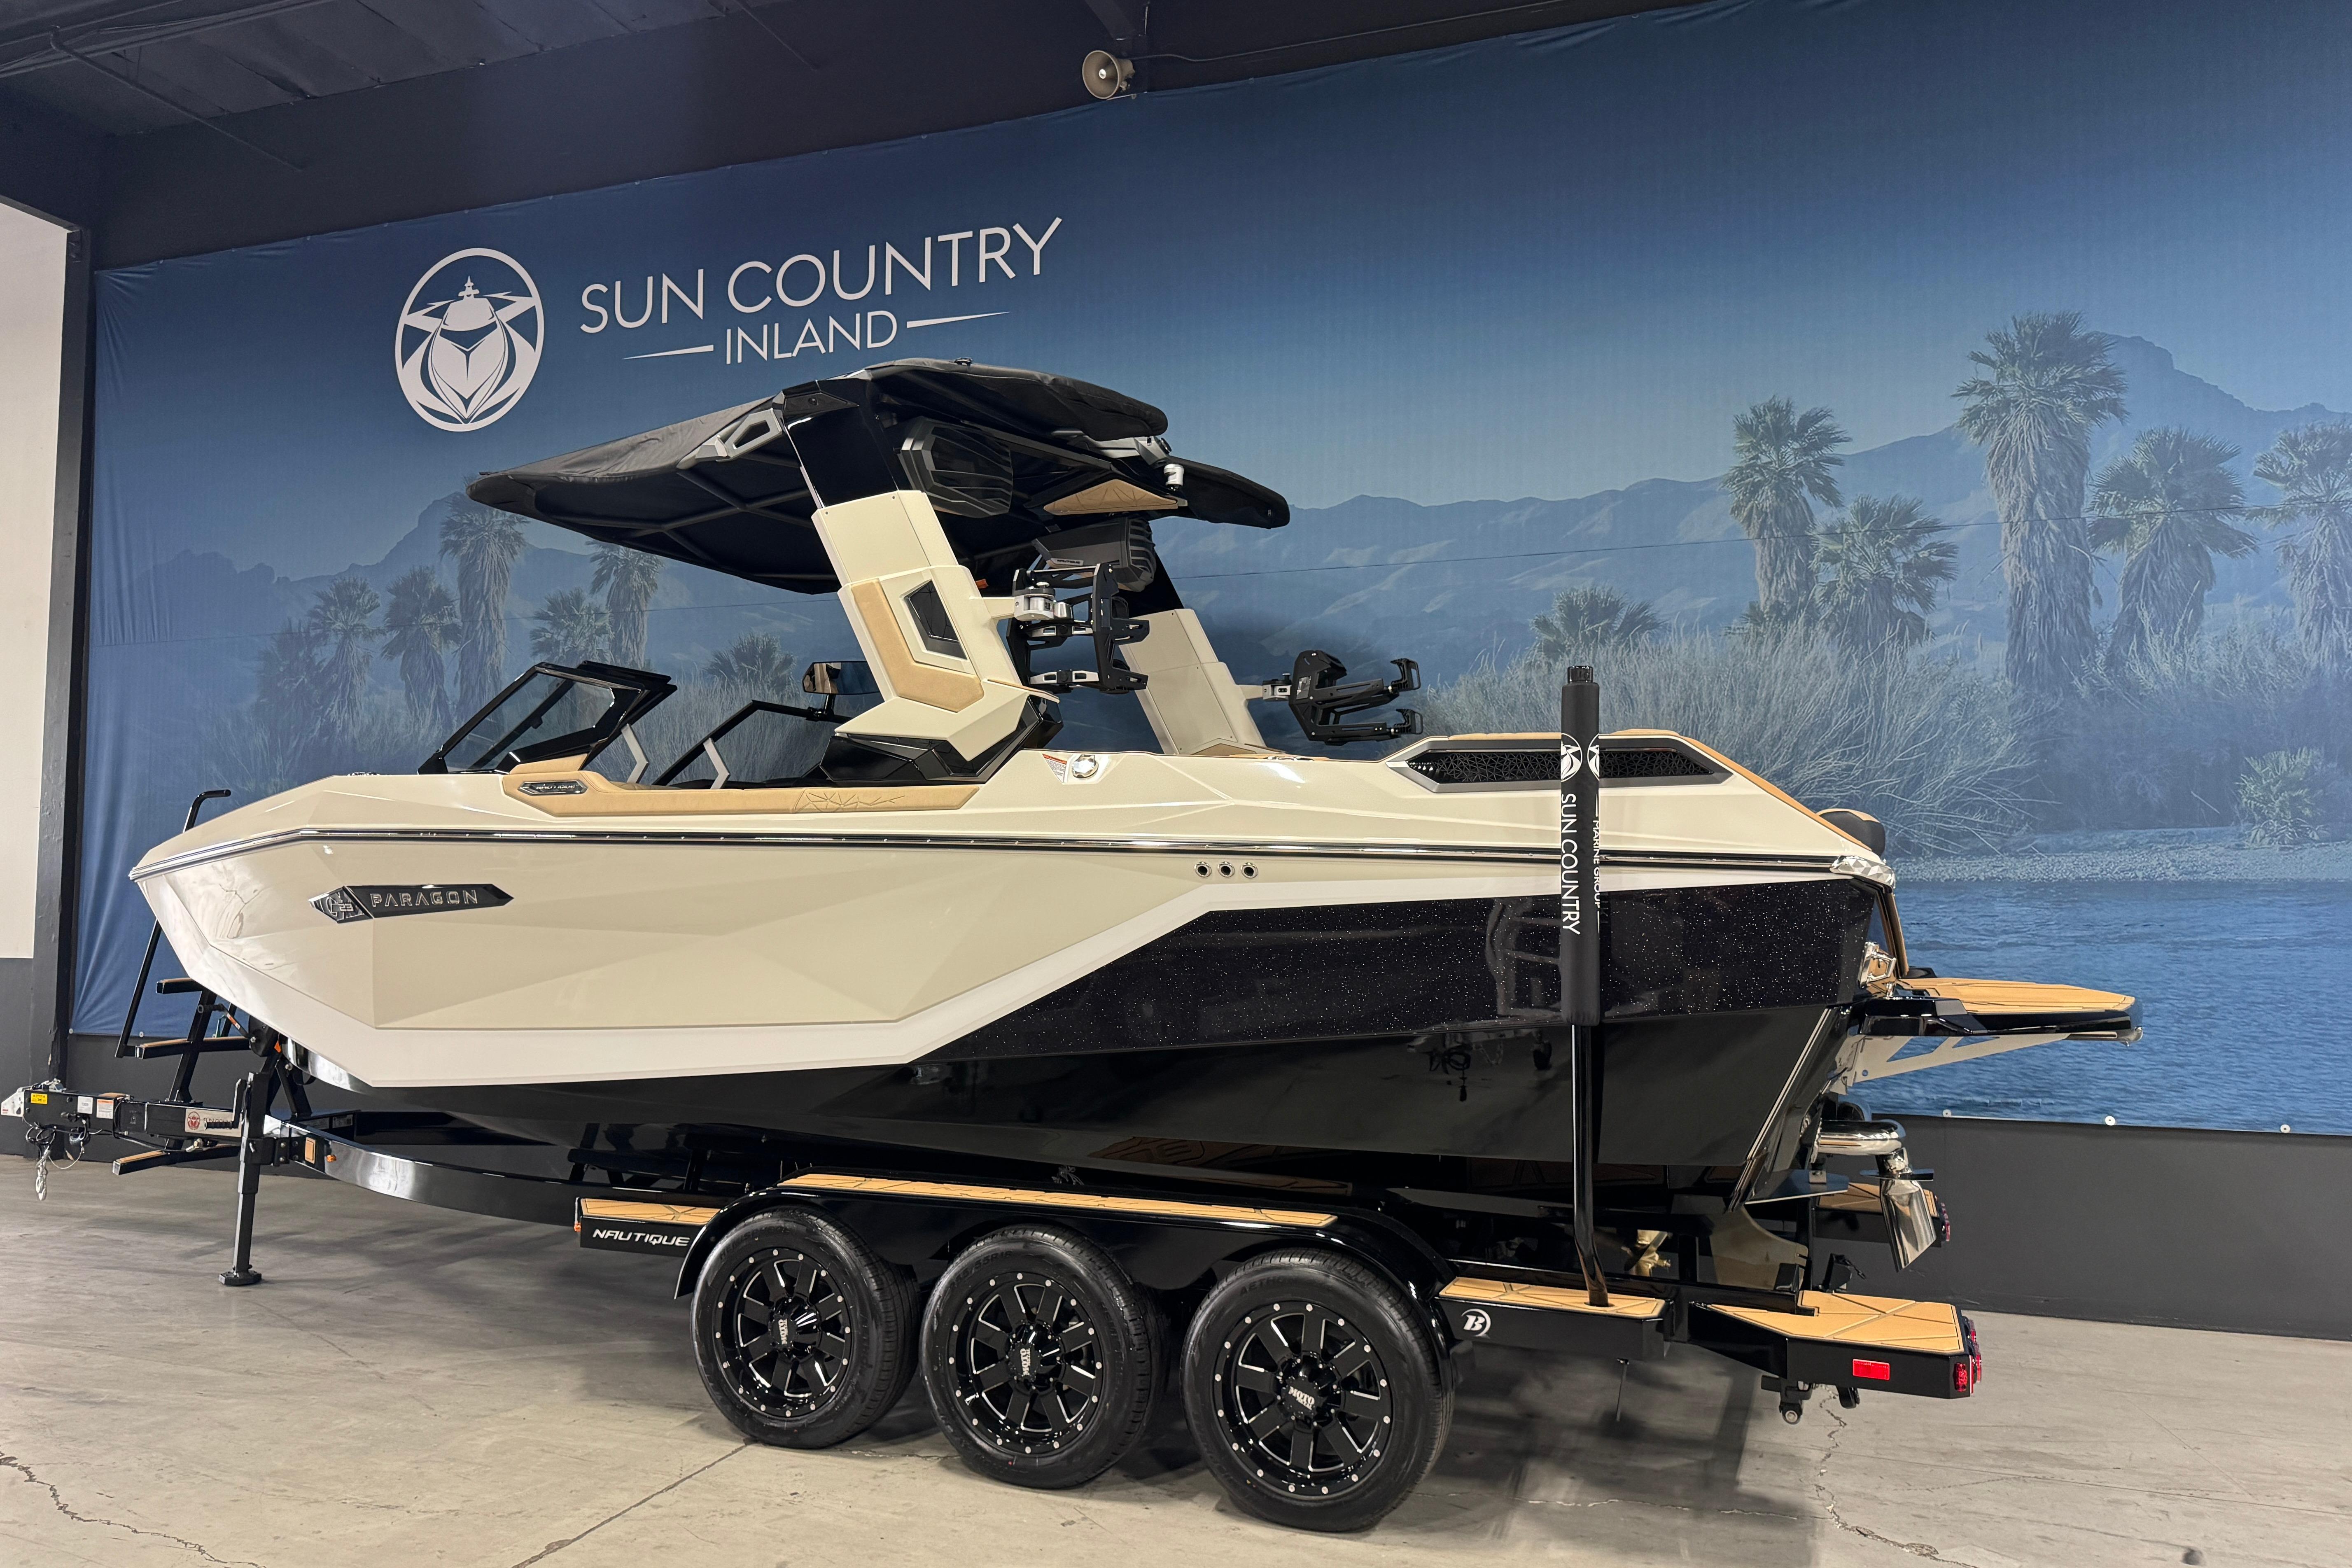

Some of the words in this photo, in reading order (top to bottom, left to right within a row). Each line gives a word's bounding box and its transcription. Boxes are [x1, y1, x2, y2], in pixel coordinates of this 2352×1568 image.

[581, 269, 703, 333] SUN
[728, 217, 1062, 313] COUNTRY
[727, 311, 897, 364] INLAND
[1561, 793, 1577, 833] SUN
[370, 890, 478, 907] PARAGON
[1561, 839, 1580, 935] COUNTRY
[593, 1229, 691, 1246] NAUTIQUE
[778, 1319, 788, 1345] MOTO
[1463, 1315, 1485, 1331] B
[1020, 1348, 1030, 1376] MOTO
[1288, 1386, 1315, 1405] MOTO
